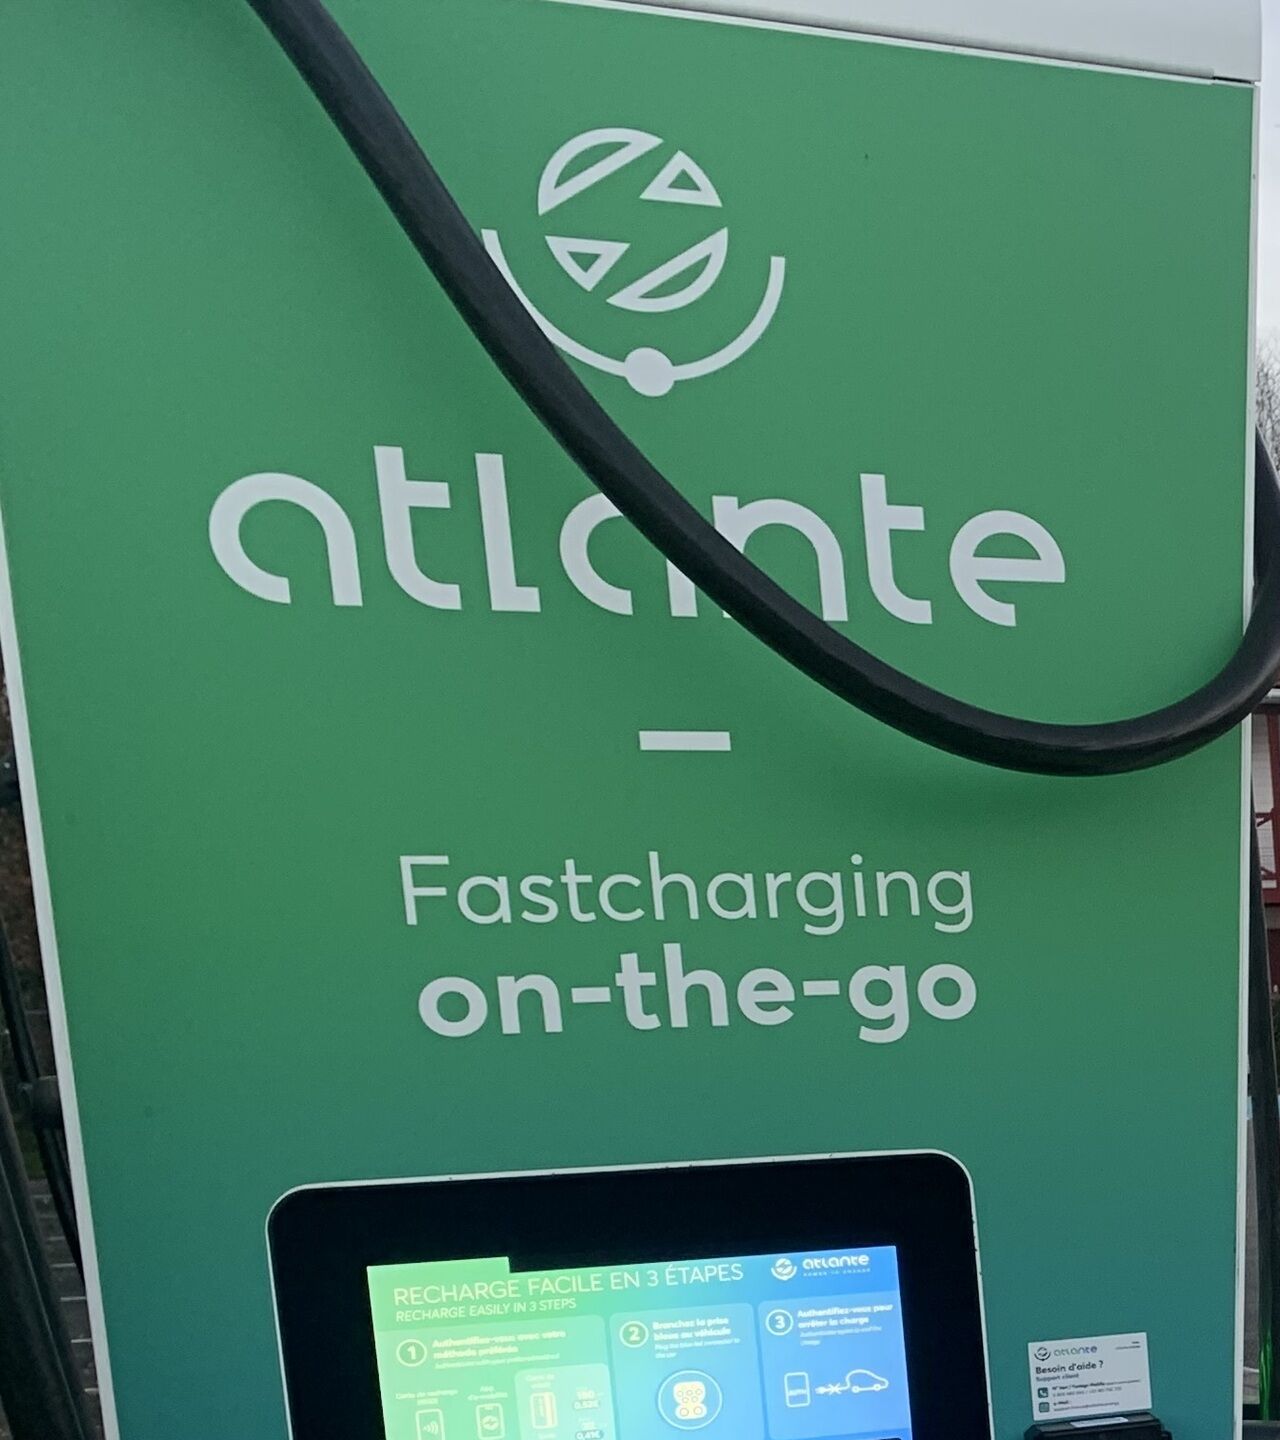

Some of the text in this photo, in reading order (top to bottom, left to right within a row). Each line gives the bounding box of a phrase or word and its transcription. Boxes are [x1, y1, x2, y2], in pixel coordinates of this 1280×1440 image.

[209, 445, 1066, 627] atlante
[400, 852, 974, 934] Fastcharging
[418, 942, 977, 1044] on-the-go
[803, 1254, 869, 1270] atlante
[394, 1263, 744, 1307] RECHARGE FACILE EN 3 ÉTAPES
[396, 1298, 577, 1323] RECHARGE EASILY IN 3 STEPS
[775, 1316, 785, 1329] 3
[628, 1328, 640, 1341] 2
[407, 1345, 417, 1360] 1
[1053, 1345, 1098, 1357] atlante
[1035, 1360, 1104, 1375] Besoin d'aide ?
